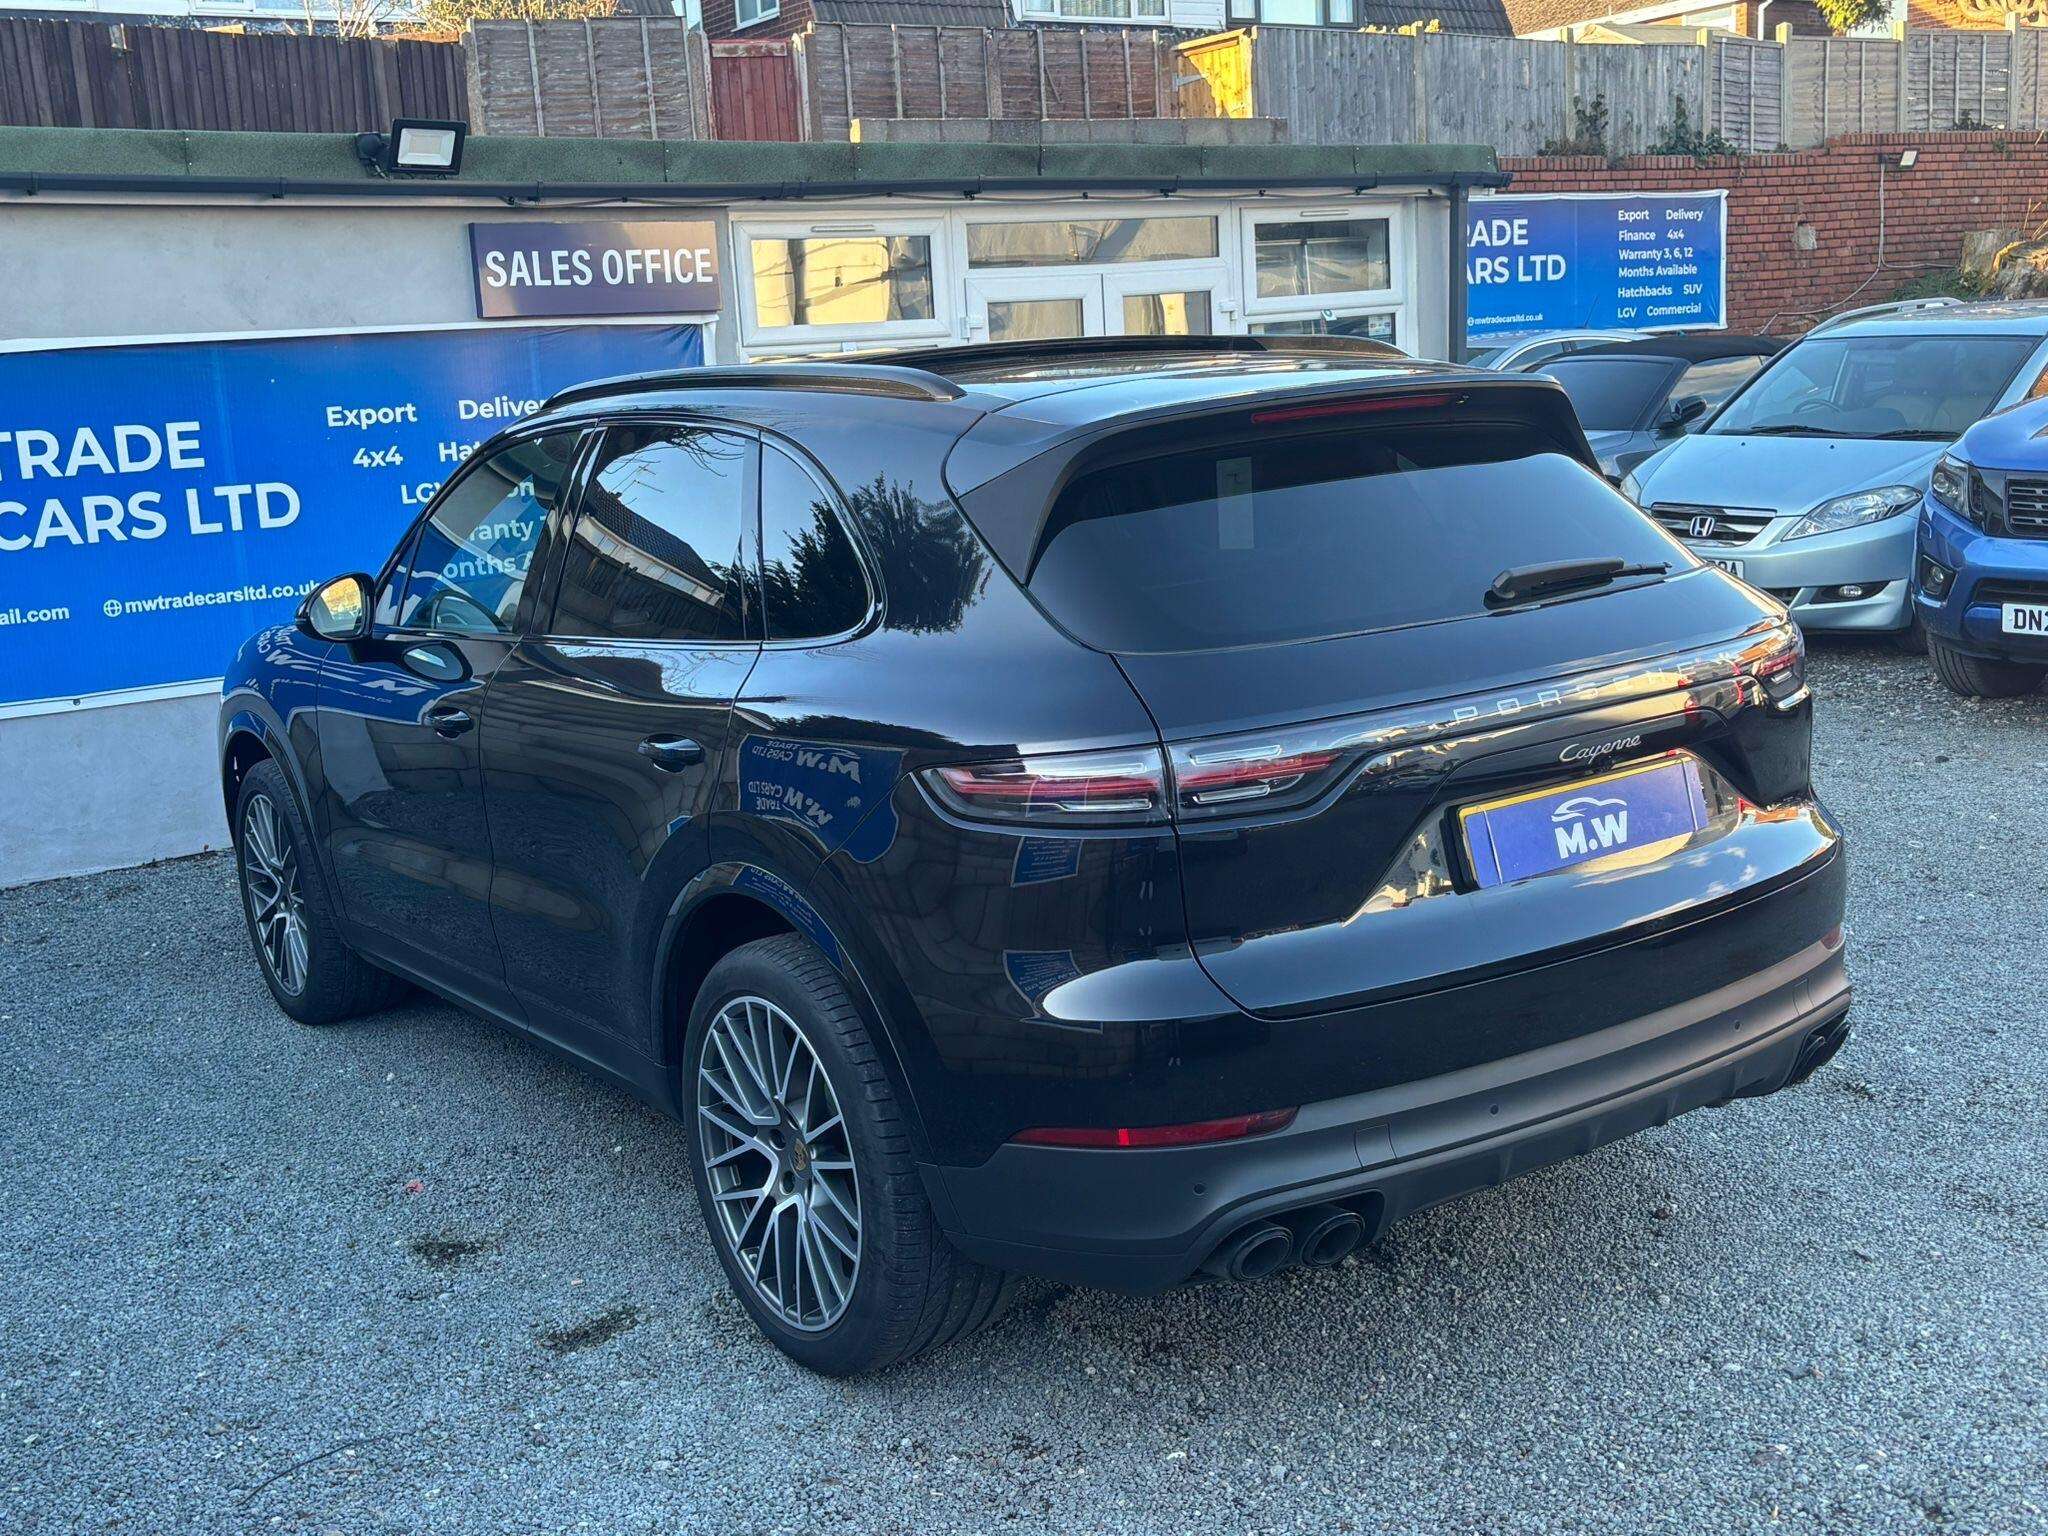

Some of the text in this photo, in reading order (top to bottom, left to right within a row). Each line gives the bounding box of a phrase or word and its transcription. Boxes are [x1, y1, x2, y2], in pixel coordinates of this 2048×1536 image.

[1618, 208, 1703, 222] Export Delivery
[1467, 219, 1529, 247] ADE
[1618, 229, 1685, 241] Finance 4x4
[1619, 246, 1693, 260] Warranty 3, 6, 12
[485, 248, 714, 288] SALES OFFICE
[1518, 254, 1566, 282] LTD
[1619, 264, 1697, 278] Months Available
[1618, 283, 1703, 298] Hatchbacks SUV
[1618, 302, 1701, 318] LGV Commercial
[326, 402, 418, 430] Export
[352, 445, 404, 468] 4x4
[0, 481, 301, 551] CARS LTD
[469, 519, 534, 542] ranty
[442, 553, 517, 581] onths
[0, 579, 321, 626] ail.com mwtradecarsltd.co.uk
[2013, 608, 2048, 632] DN
[1558, 733, 1642, 764] Cayenne
[1554, 810, 1628, 859] M.W
